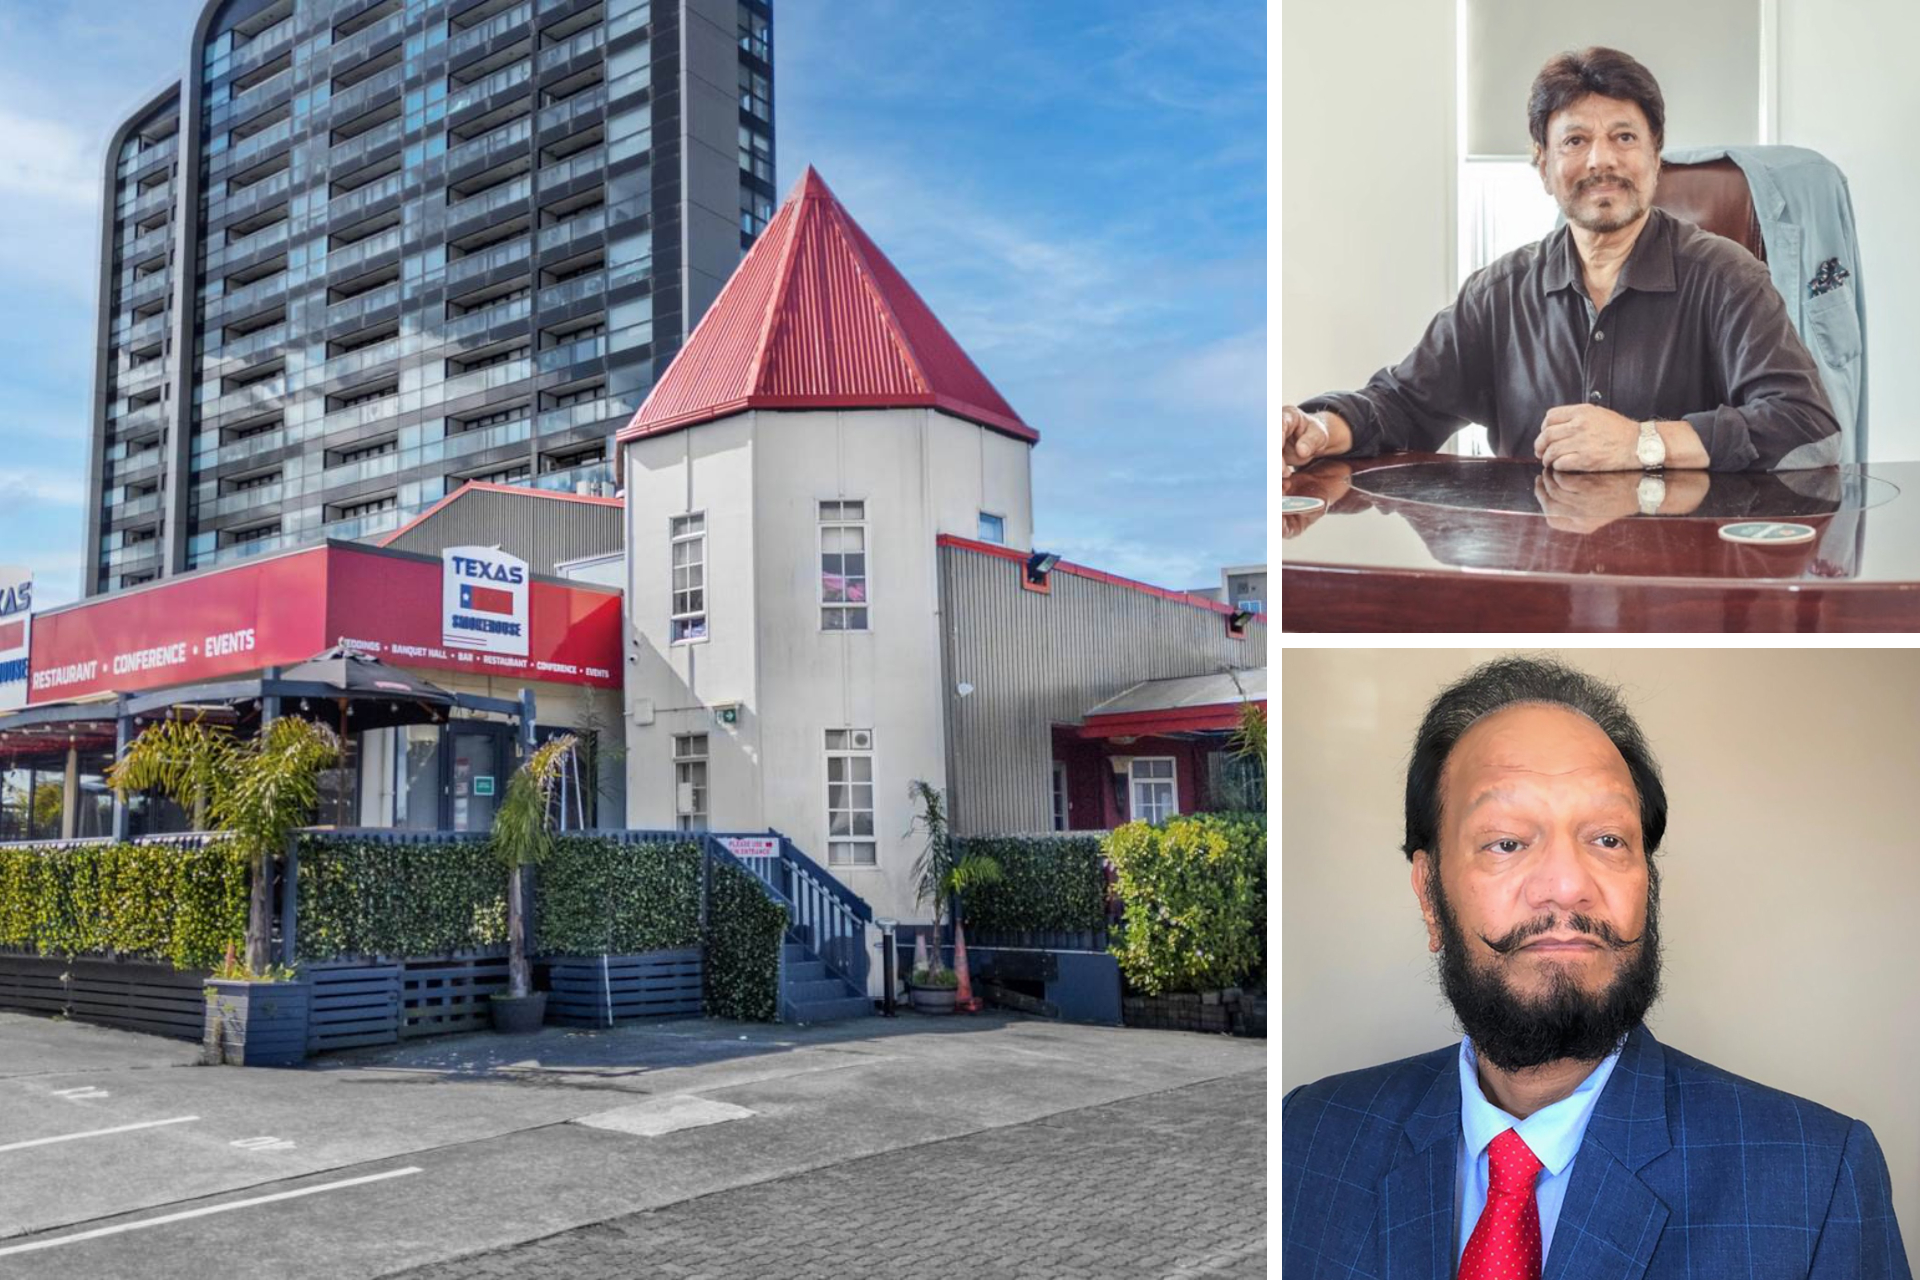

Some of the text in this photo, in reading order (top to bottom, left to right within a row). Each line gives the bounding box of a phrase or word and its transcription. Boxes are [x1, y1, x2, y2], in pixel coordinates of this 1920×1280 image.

[452, 556, 523, 584] TEXAS
[452, 614, 522, 637] SMOKEHOUSE
[32, 628, 255, 690] RESTAURANT CONFERENCE EVENTS
[342, 638, 610, 678] EDDINGS BANQUET HALL BAR RESTAURANT CONFERENCE EVENTS
